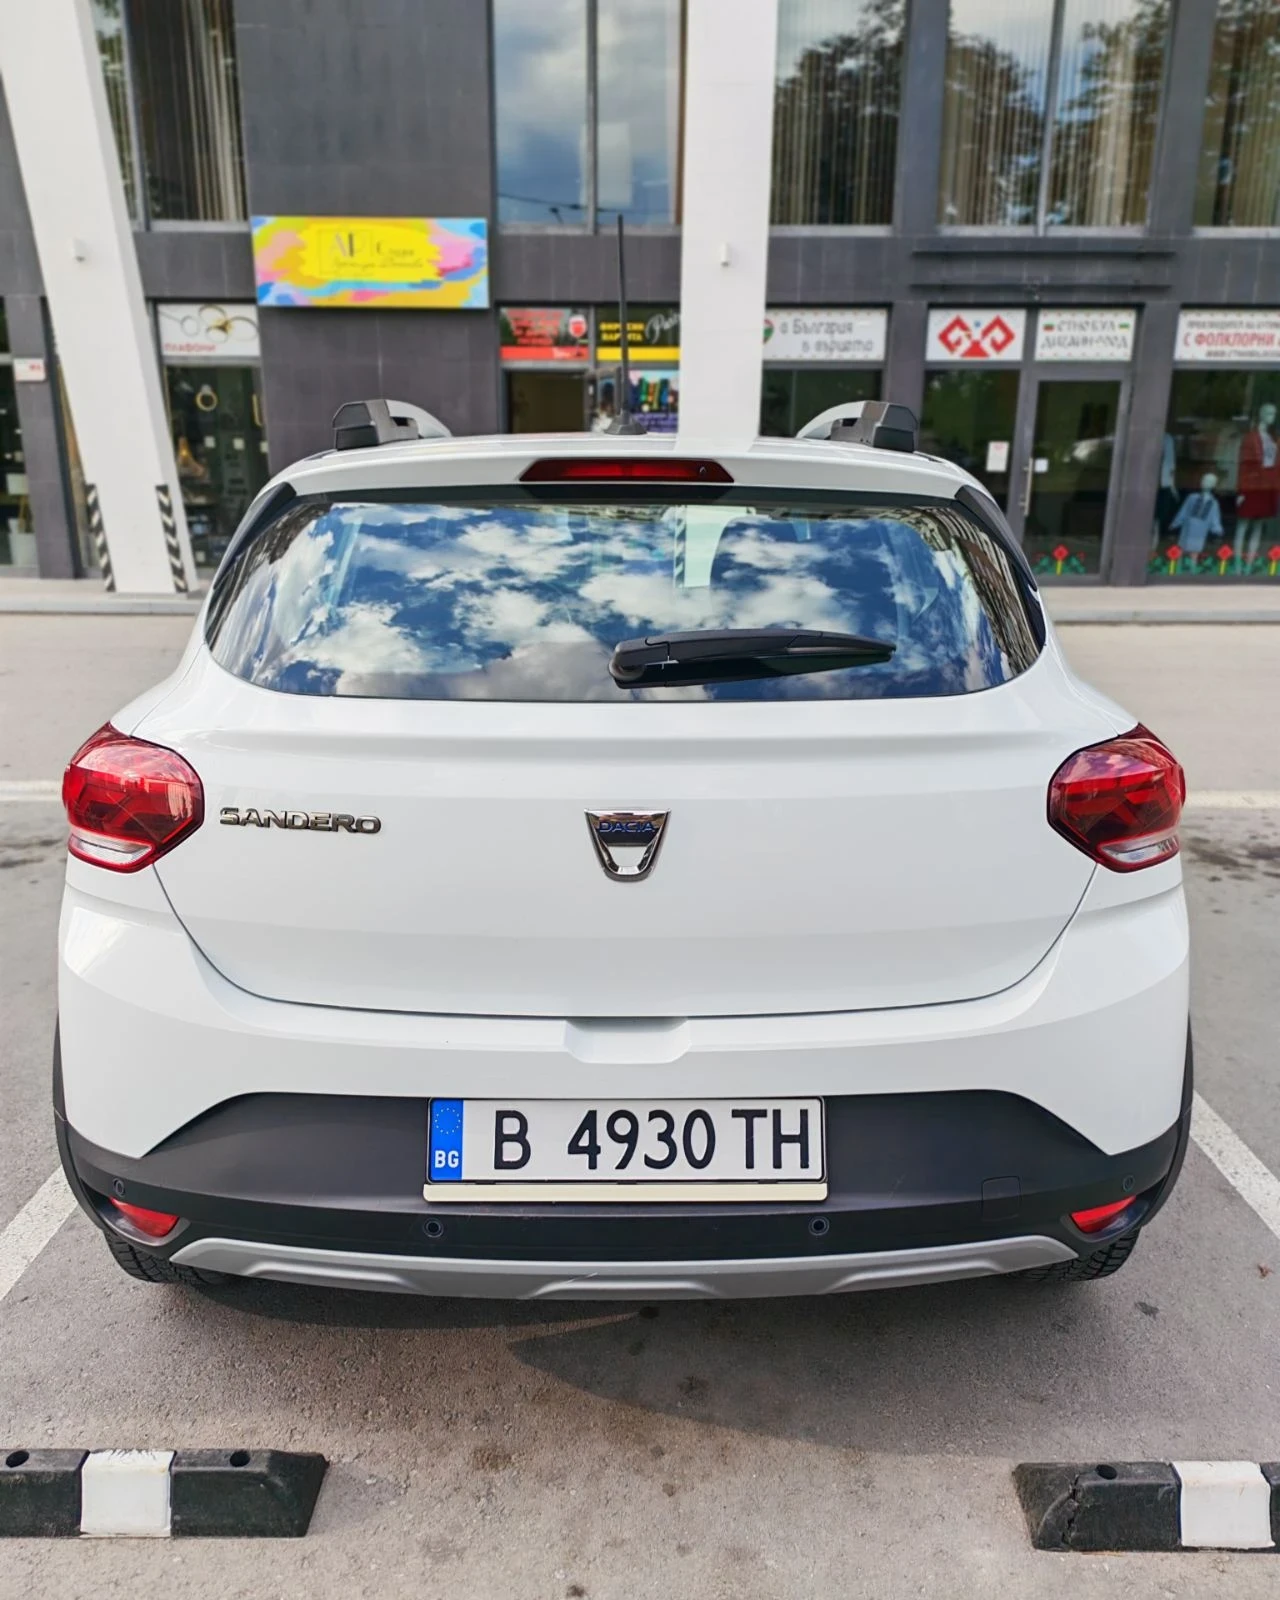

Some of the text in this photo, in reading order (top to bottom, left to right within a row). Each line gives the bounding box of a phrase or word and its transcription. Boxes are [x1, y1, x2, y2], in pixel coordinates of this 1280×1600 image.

[1195, 332, 1275, 347] ФОЛКЛОРНИ
[219, 806, 382, 835] SANDERO
[600, 822, 656, 833] DACIA
[494, 1109, 809, 1170] B 4930 TH
[434, 1150, 459, 1169] BG
